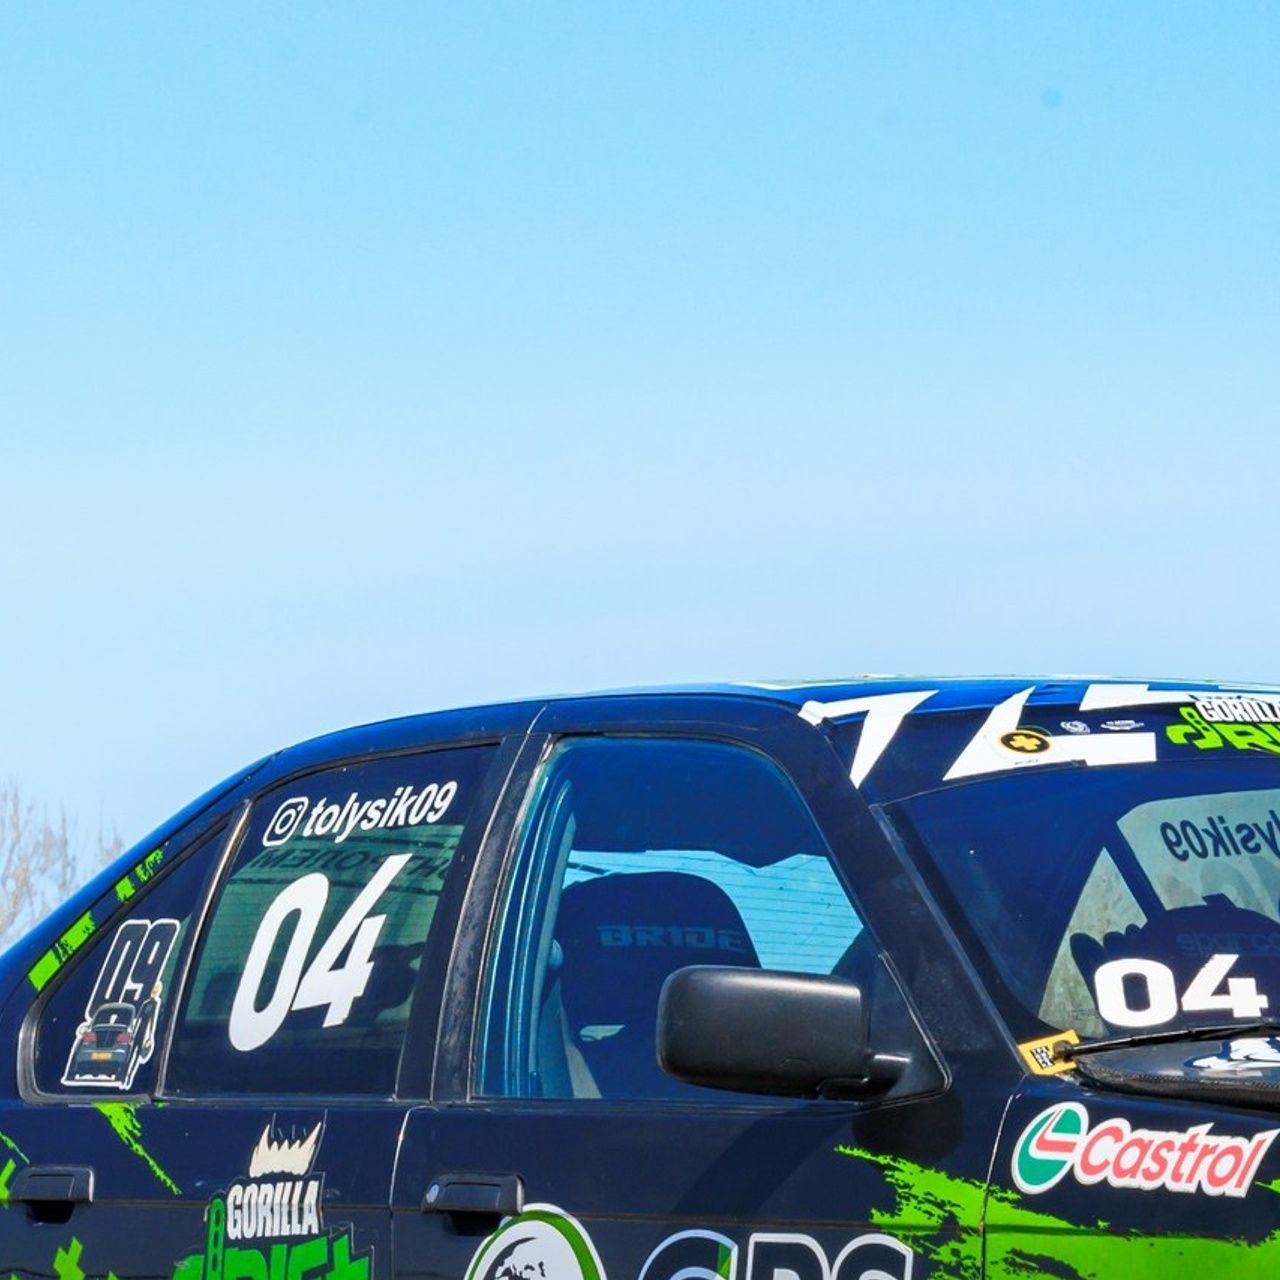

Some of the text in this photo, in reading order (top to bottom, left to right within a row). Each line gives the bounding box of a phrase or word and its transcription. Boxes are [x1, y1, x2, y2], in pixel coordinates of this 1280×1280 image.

[302, 780, 458, 844] tolysik09
[228, 852, 413, 1053] 04
[598, 924, 748, 953] BRIDE
[1094, 953, 1269, 1028] 04
[1080, 1126, 1266, 1189] Castrol
[226, 1180, 320, 1241] GORILLA
